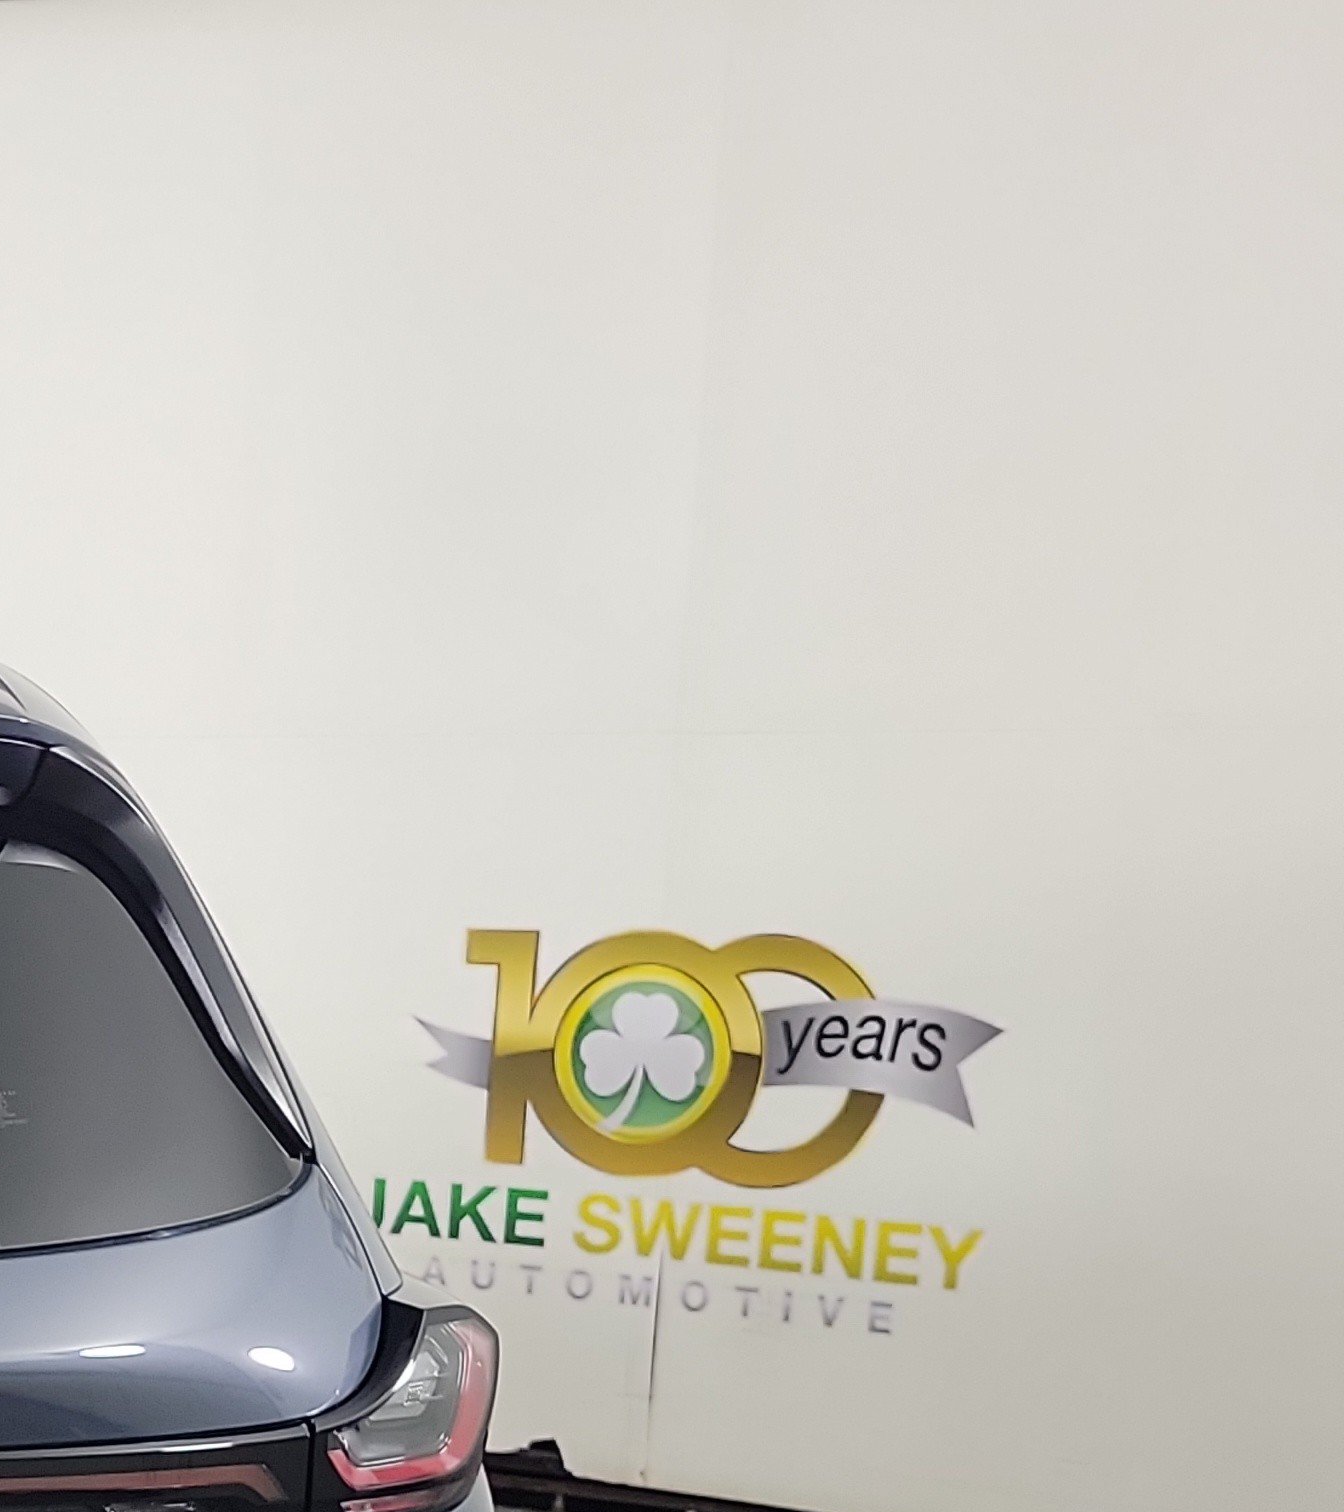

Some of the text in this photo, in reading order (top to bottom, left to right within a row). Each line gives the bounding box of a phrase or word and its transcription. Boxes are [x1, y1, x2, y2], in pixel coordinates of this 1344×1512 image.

[466, 929, 885, 1189] 100
[775, 1013, 948, 1075] years
[573, 1192, 985, 1291] SWEENEY
[422, 1255, 894, 1335] AUTOMOTIVE
